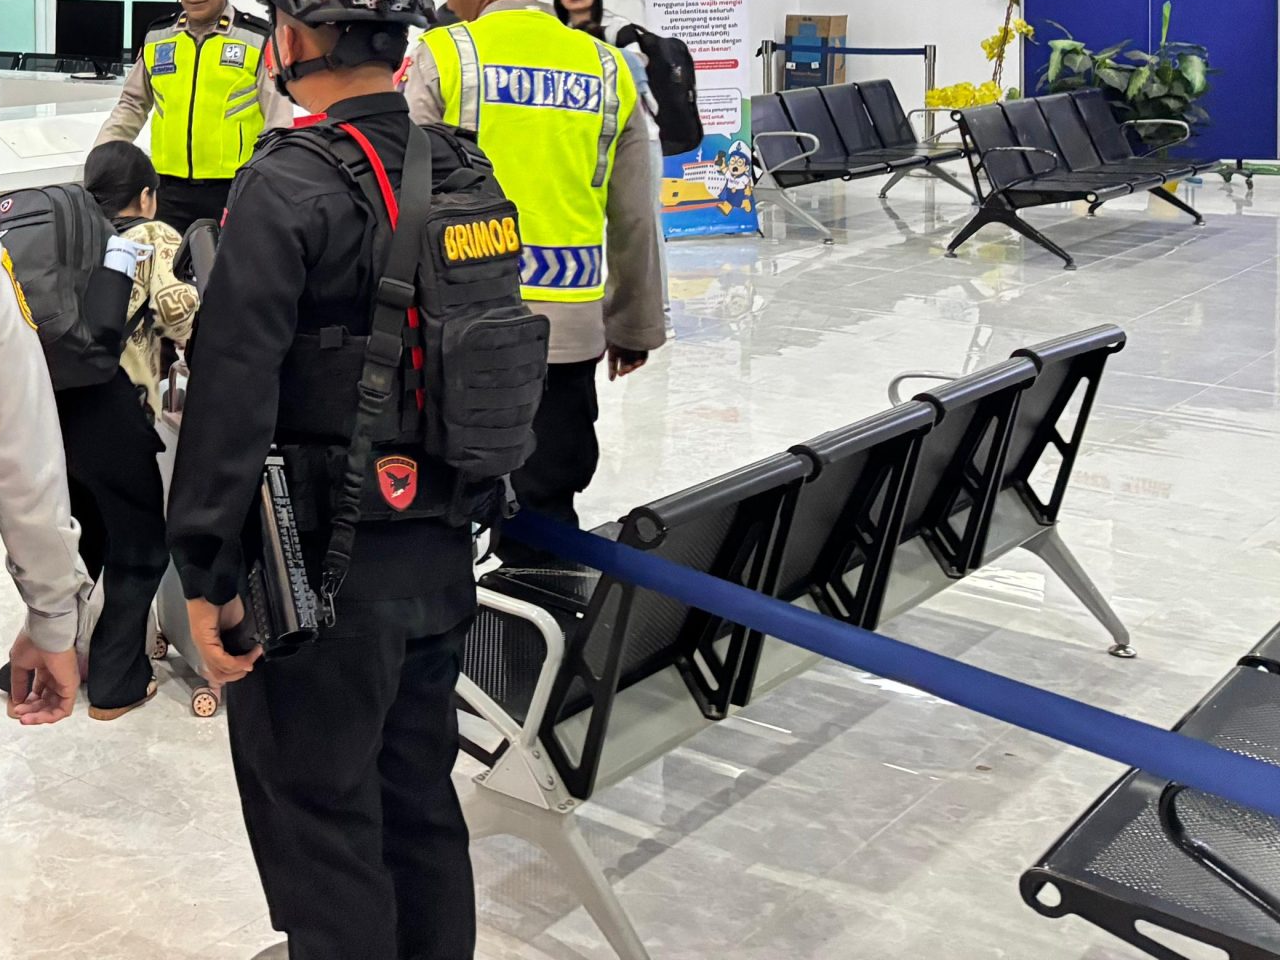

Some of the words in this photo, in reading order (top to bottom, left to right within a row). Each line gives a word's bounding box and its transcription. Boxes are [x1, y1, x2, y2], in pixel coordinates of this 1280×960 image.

[653, 1, 685, 10] Pengguna
[700, 0, 718, 8] wajib
[669, 16, 708, 24] penumpang
[680, 23, 710, 31] pengenal
[483, 66, 600, 111] POLISI
[444, 216, 519, 262] BRIMOB
